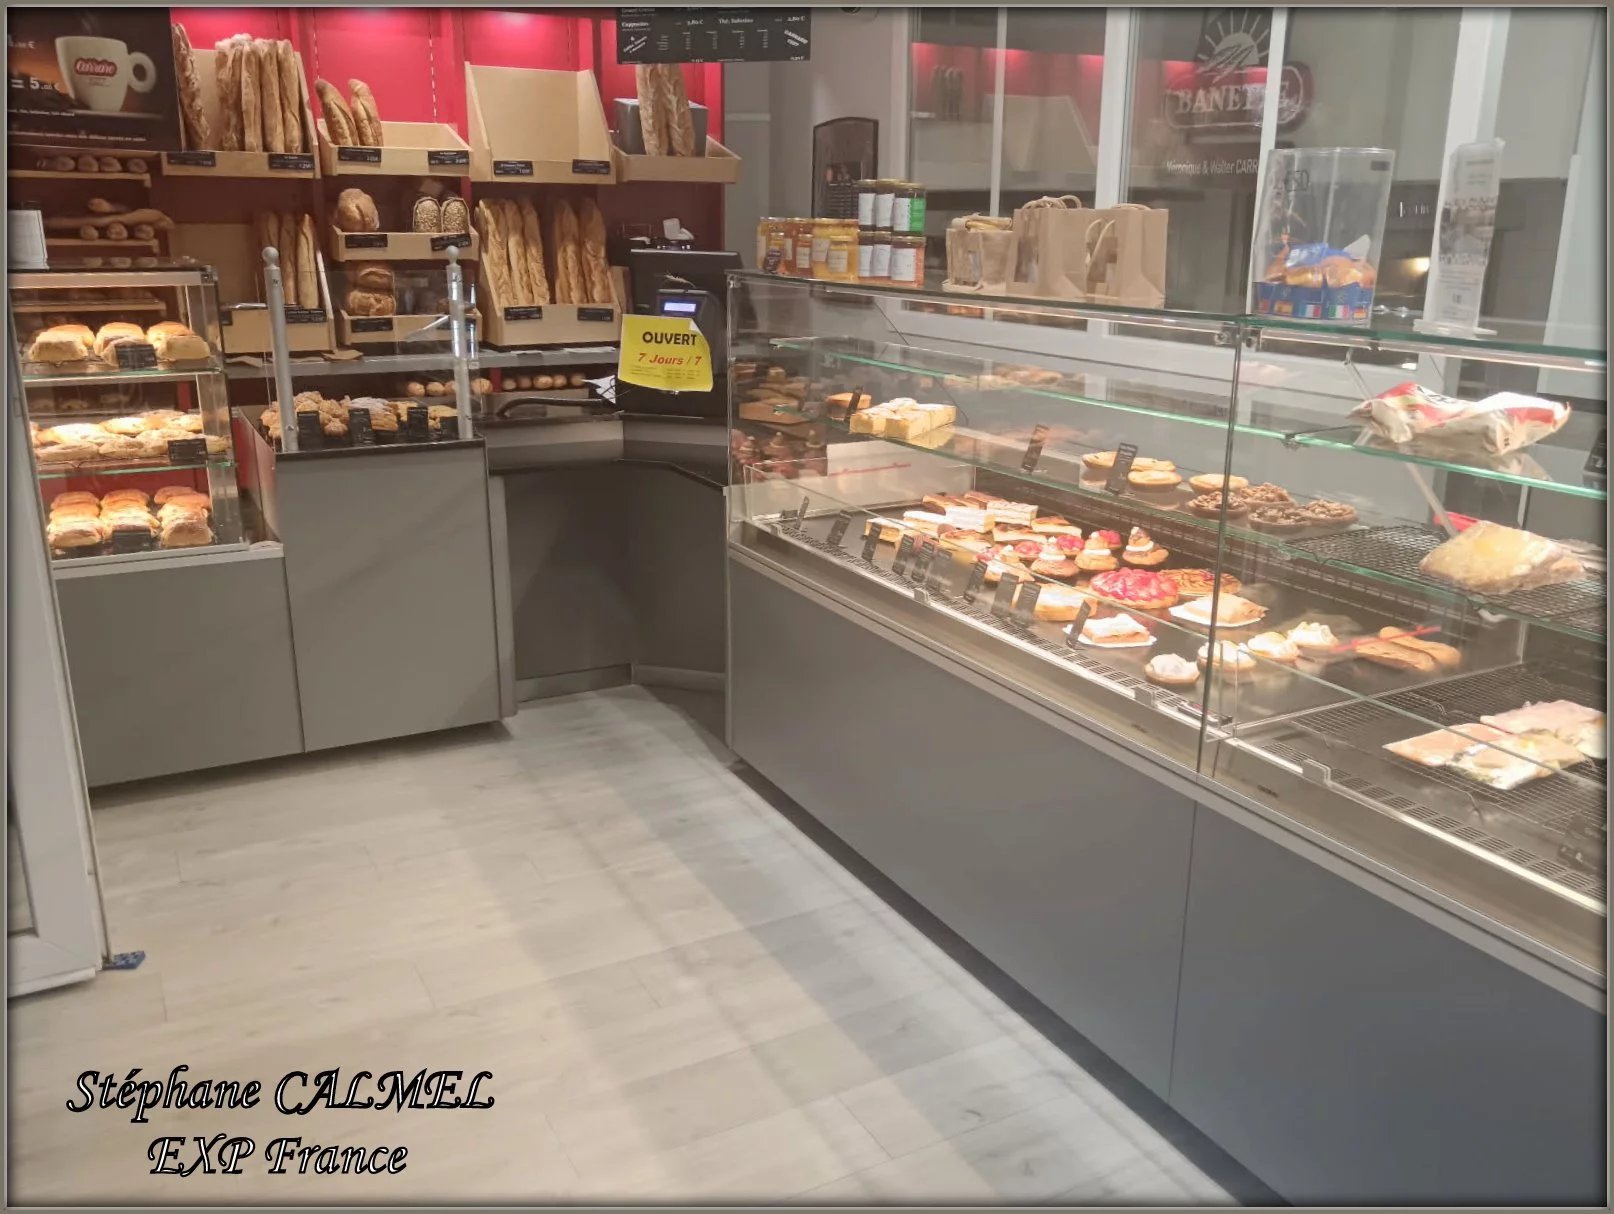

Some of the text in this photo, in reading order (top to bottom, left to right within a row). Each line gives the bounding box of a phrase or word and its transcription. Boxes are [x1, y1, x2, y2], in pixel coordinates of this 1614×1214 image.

[1175, 81, 1290, 113] BANETE
[642, 331, 697, 346] OUVERT
[638, 352, 647, 362] 7
[649, 354, 684, 366] Jours
[693, 356, 702, 366] 7
